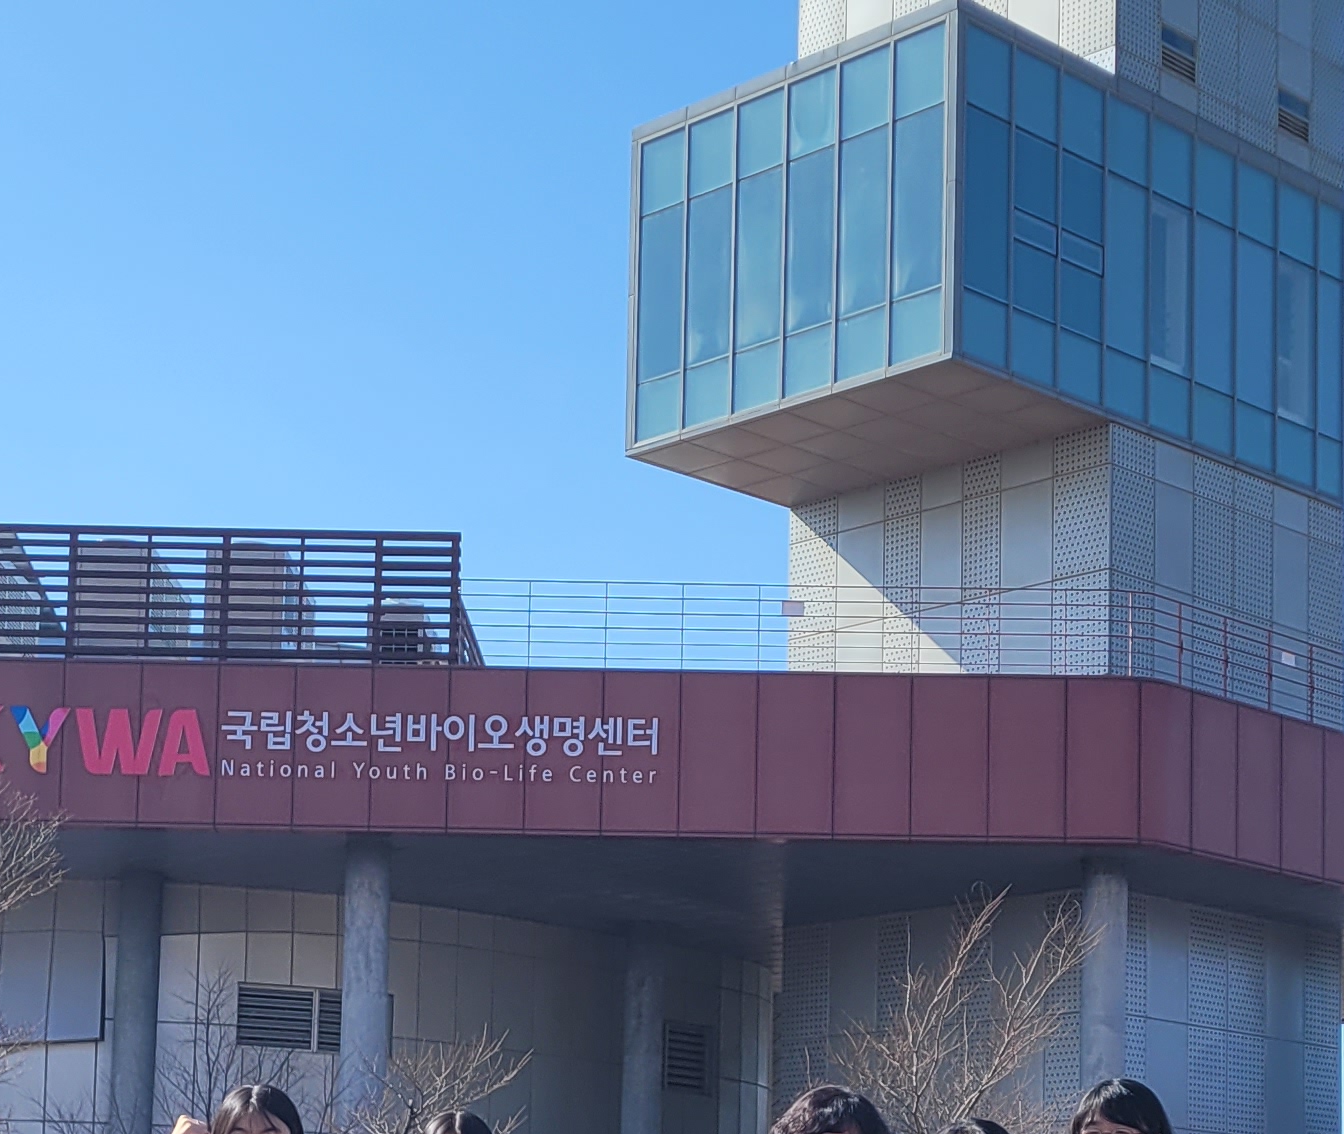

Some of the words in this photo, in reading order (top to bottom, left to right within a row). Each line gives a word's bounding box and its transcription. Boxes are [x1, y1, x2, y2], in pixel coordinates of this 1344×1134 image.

[221, 710, 659, 757] 국립청소년바이오생명센터
[221, 759, 336, 778] National
[353, 762, 427, 780] Youth
[445, 763, 554, 783] Bio-Life
[570, 766, 658, 784] Center
